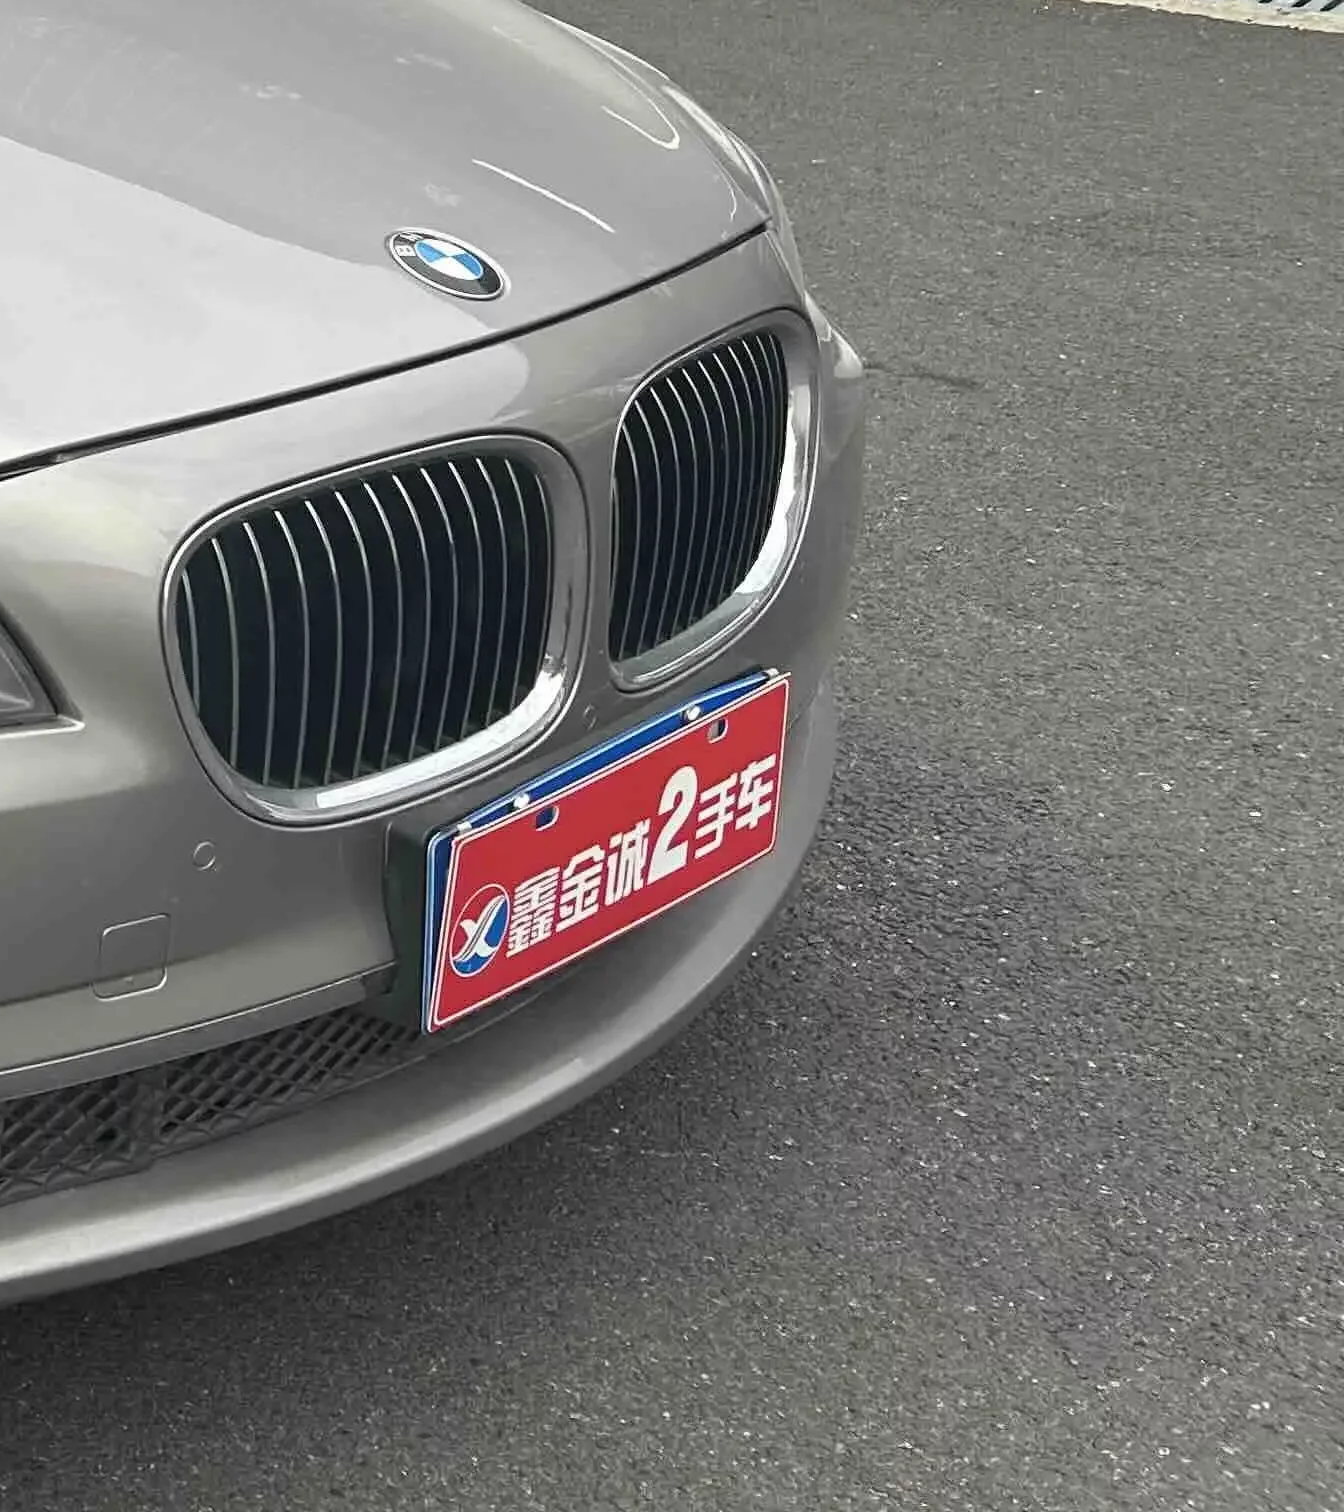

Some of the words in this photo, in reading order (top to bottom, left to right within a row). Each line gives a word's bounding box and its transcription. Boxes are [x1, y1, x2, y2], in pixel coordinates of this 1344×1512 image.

[505, 754, 777, 958] 鑫金诚2手车
